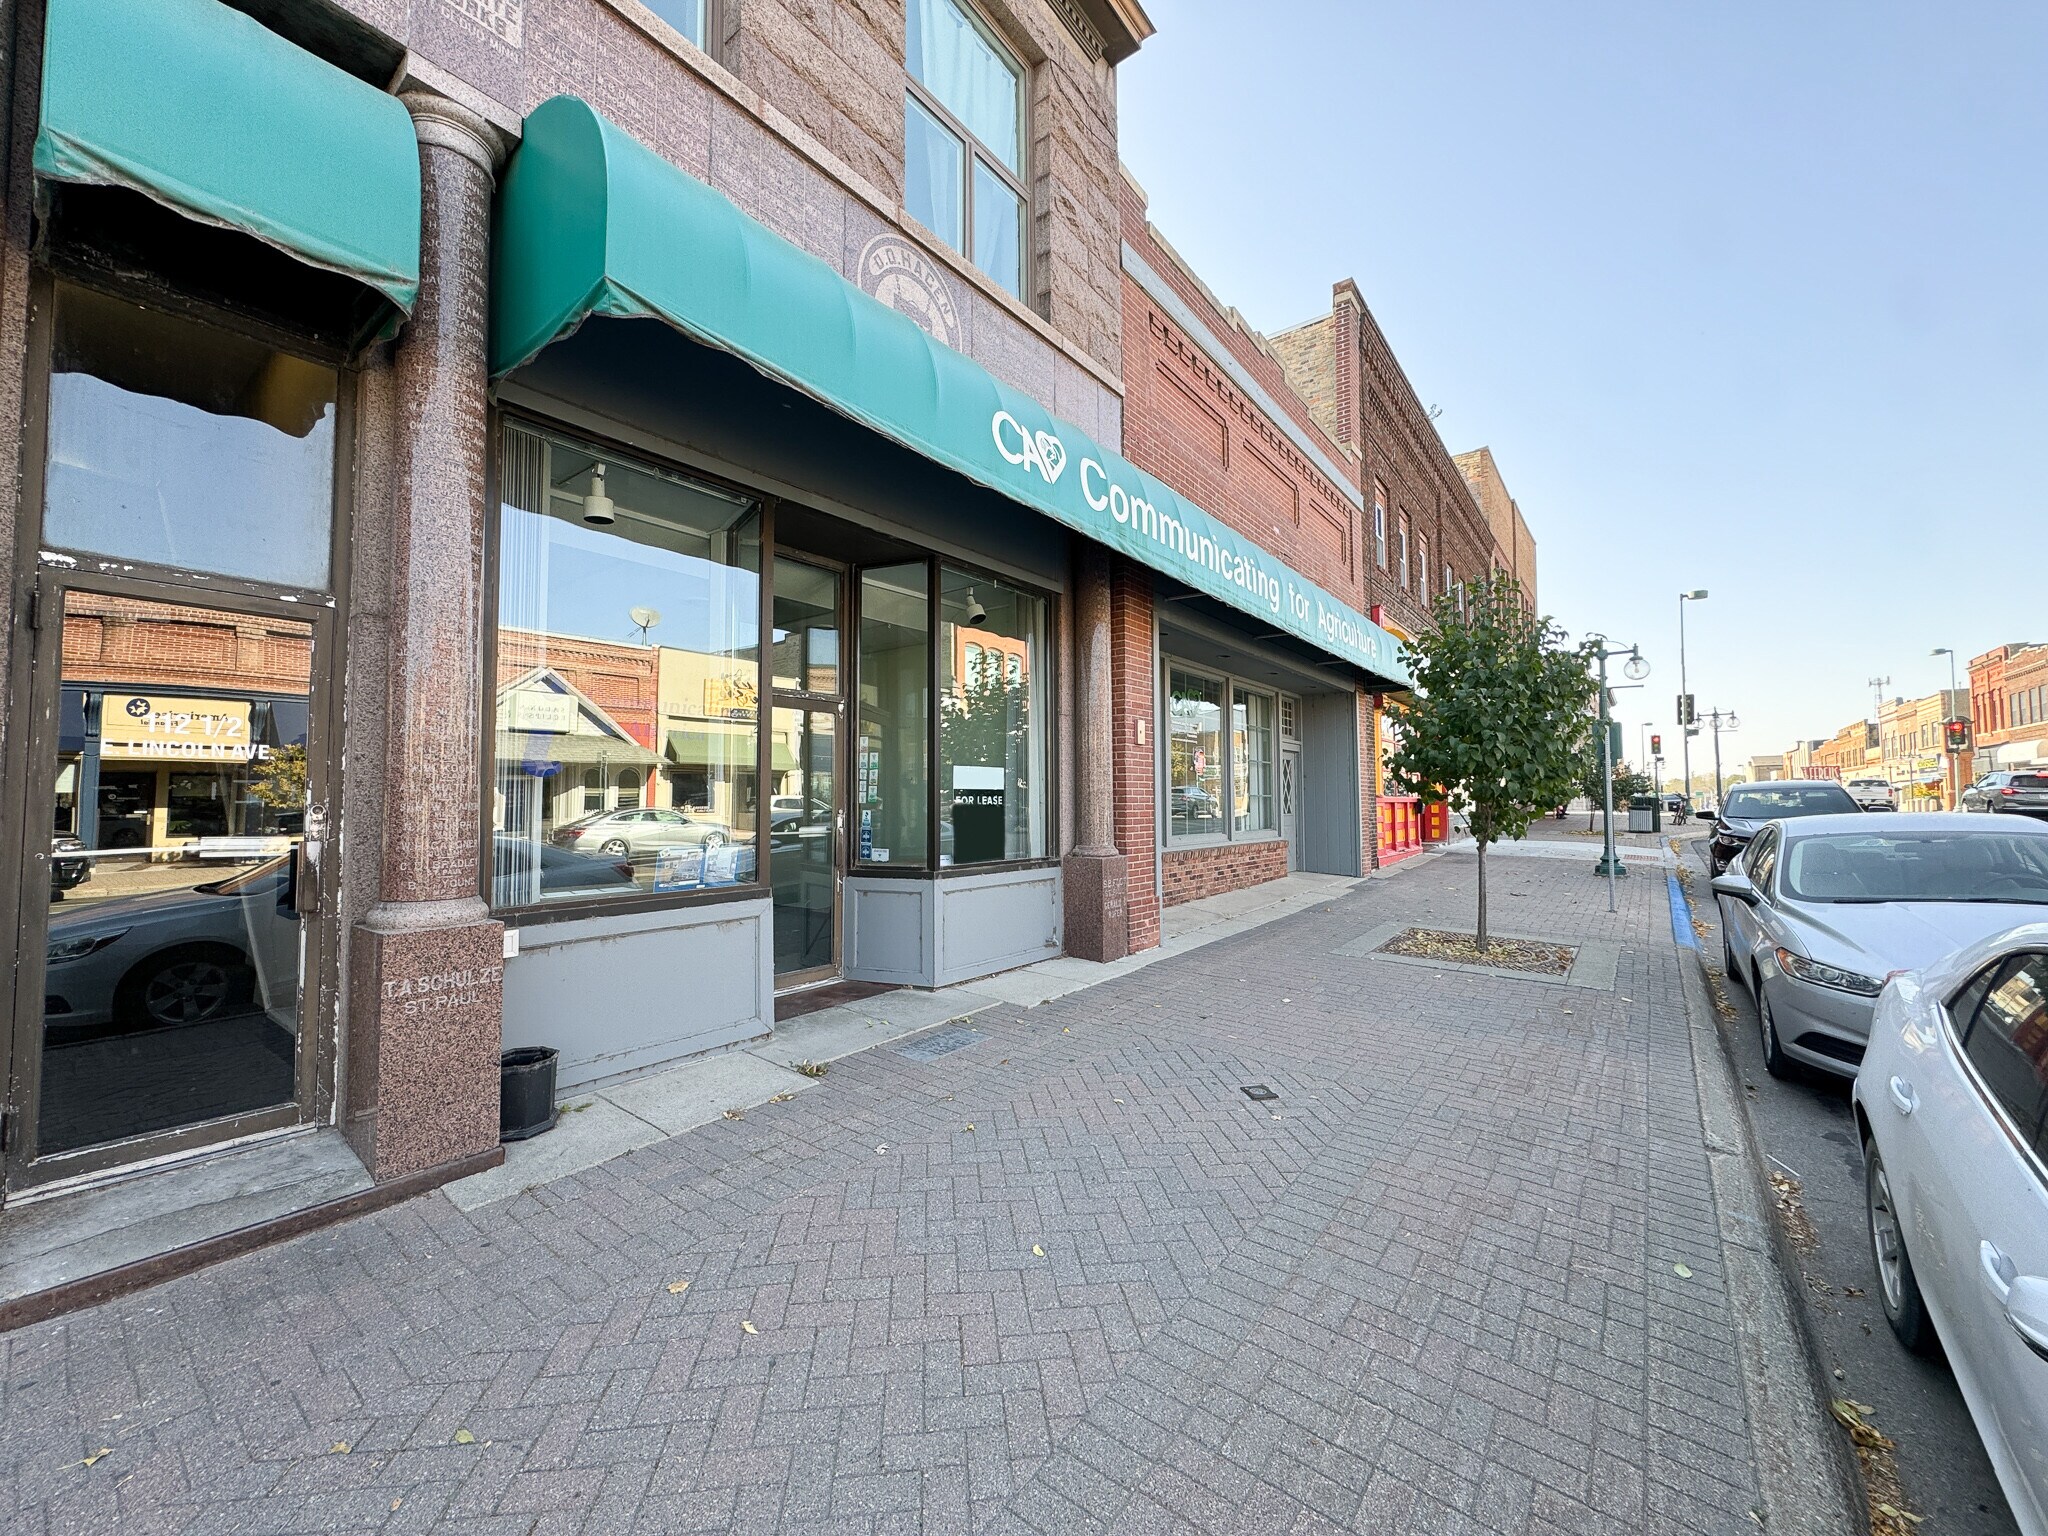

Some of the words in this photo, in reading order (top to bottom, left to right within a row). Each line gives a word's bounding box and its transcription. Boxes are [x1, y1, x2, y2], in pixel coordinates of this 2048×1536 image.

[1079, 457, 1279, 613] Communicating
[1288, 583, 1310, 623] for
[1318, 601, 1377, 659] Agriculture
[147, 711, 190, 735] 112
[199, 715, 243, 739] 1/2
[100, 737, 120, 756] E.
[128, 739, 225, 759] LINCOLN
[231, 743, 275, 761] AVE.
[955, 795, 974, 805] FOR
[977, 795, 1003, 805] LEASE
[418, 966, 503, 993] SCHULZE
[436, 990, 483, 1009] PAUL
